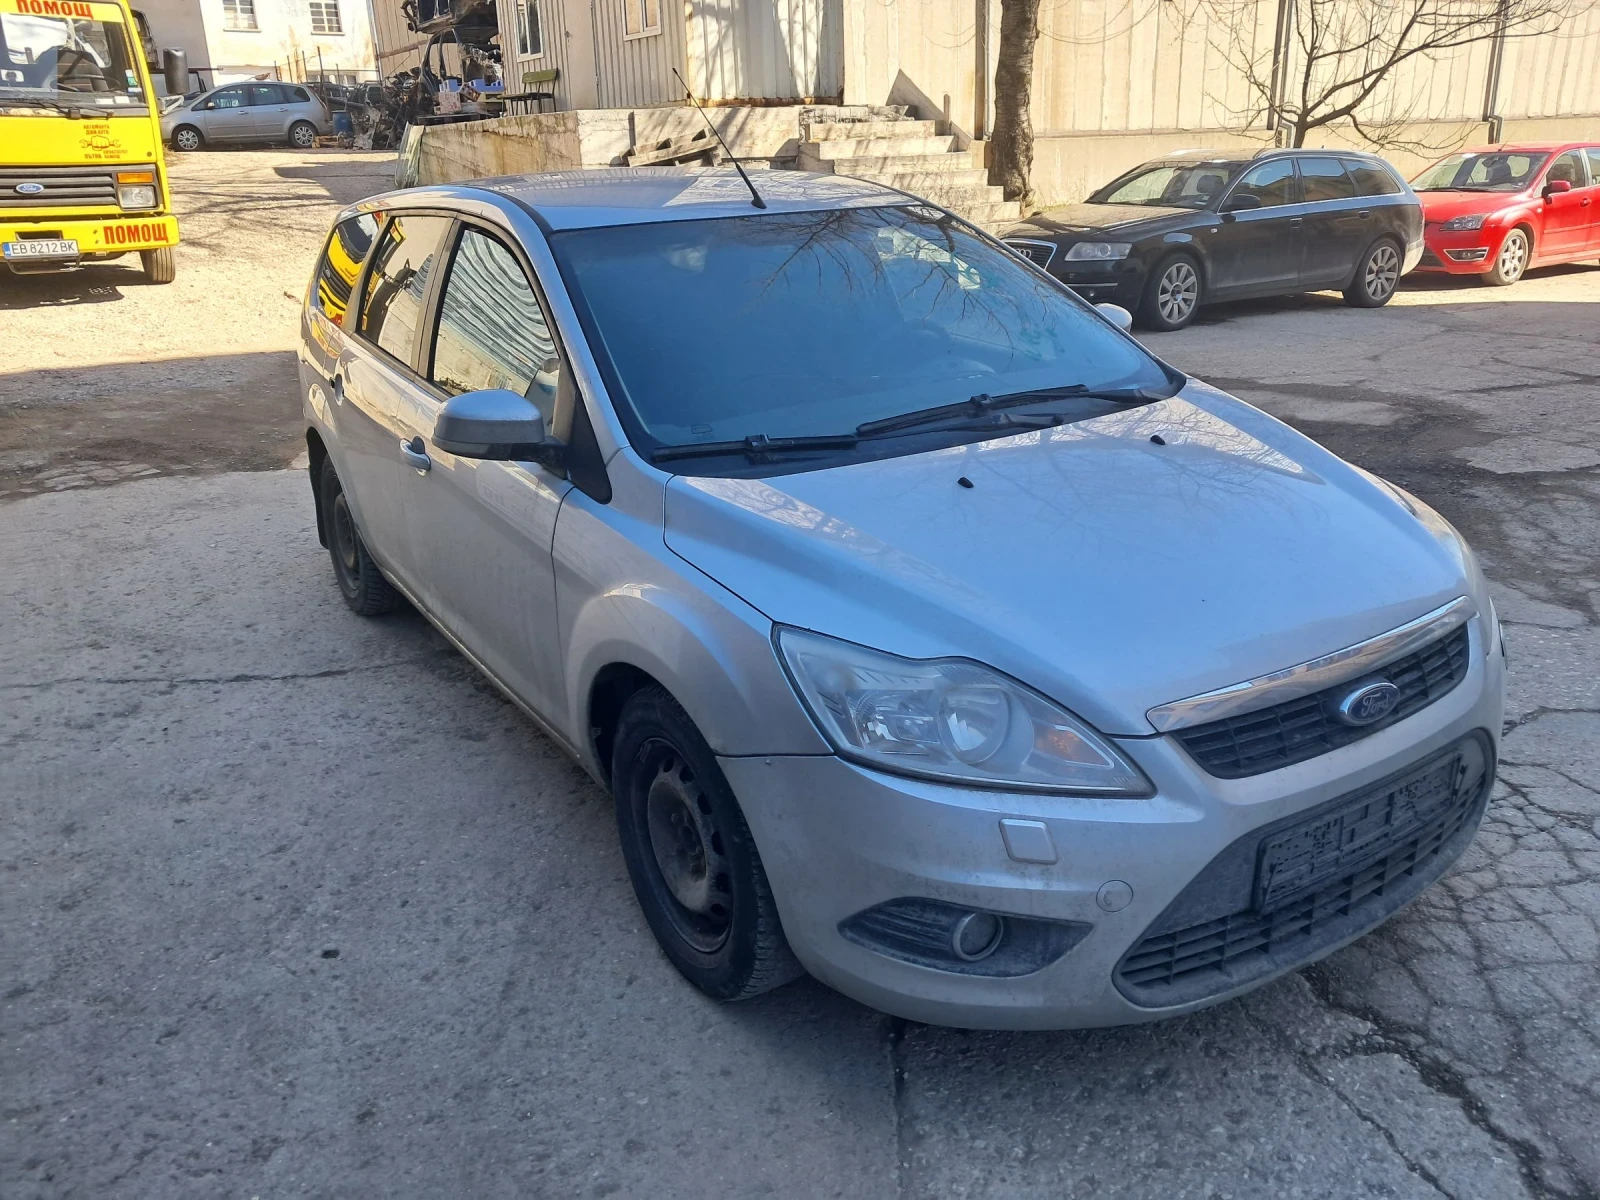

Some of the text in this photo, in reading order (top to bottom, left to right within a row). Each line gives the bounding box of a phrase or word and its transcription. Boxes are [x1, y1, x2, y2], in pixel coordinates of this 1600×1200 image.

[16, 0, 94, 20] ПОМОЩ
[103, 223, 169, 243] ПОМОЩ
[29, 242, 59, 254] 8212
[1361, 691, 1389, 717] Ford
